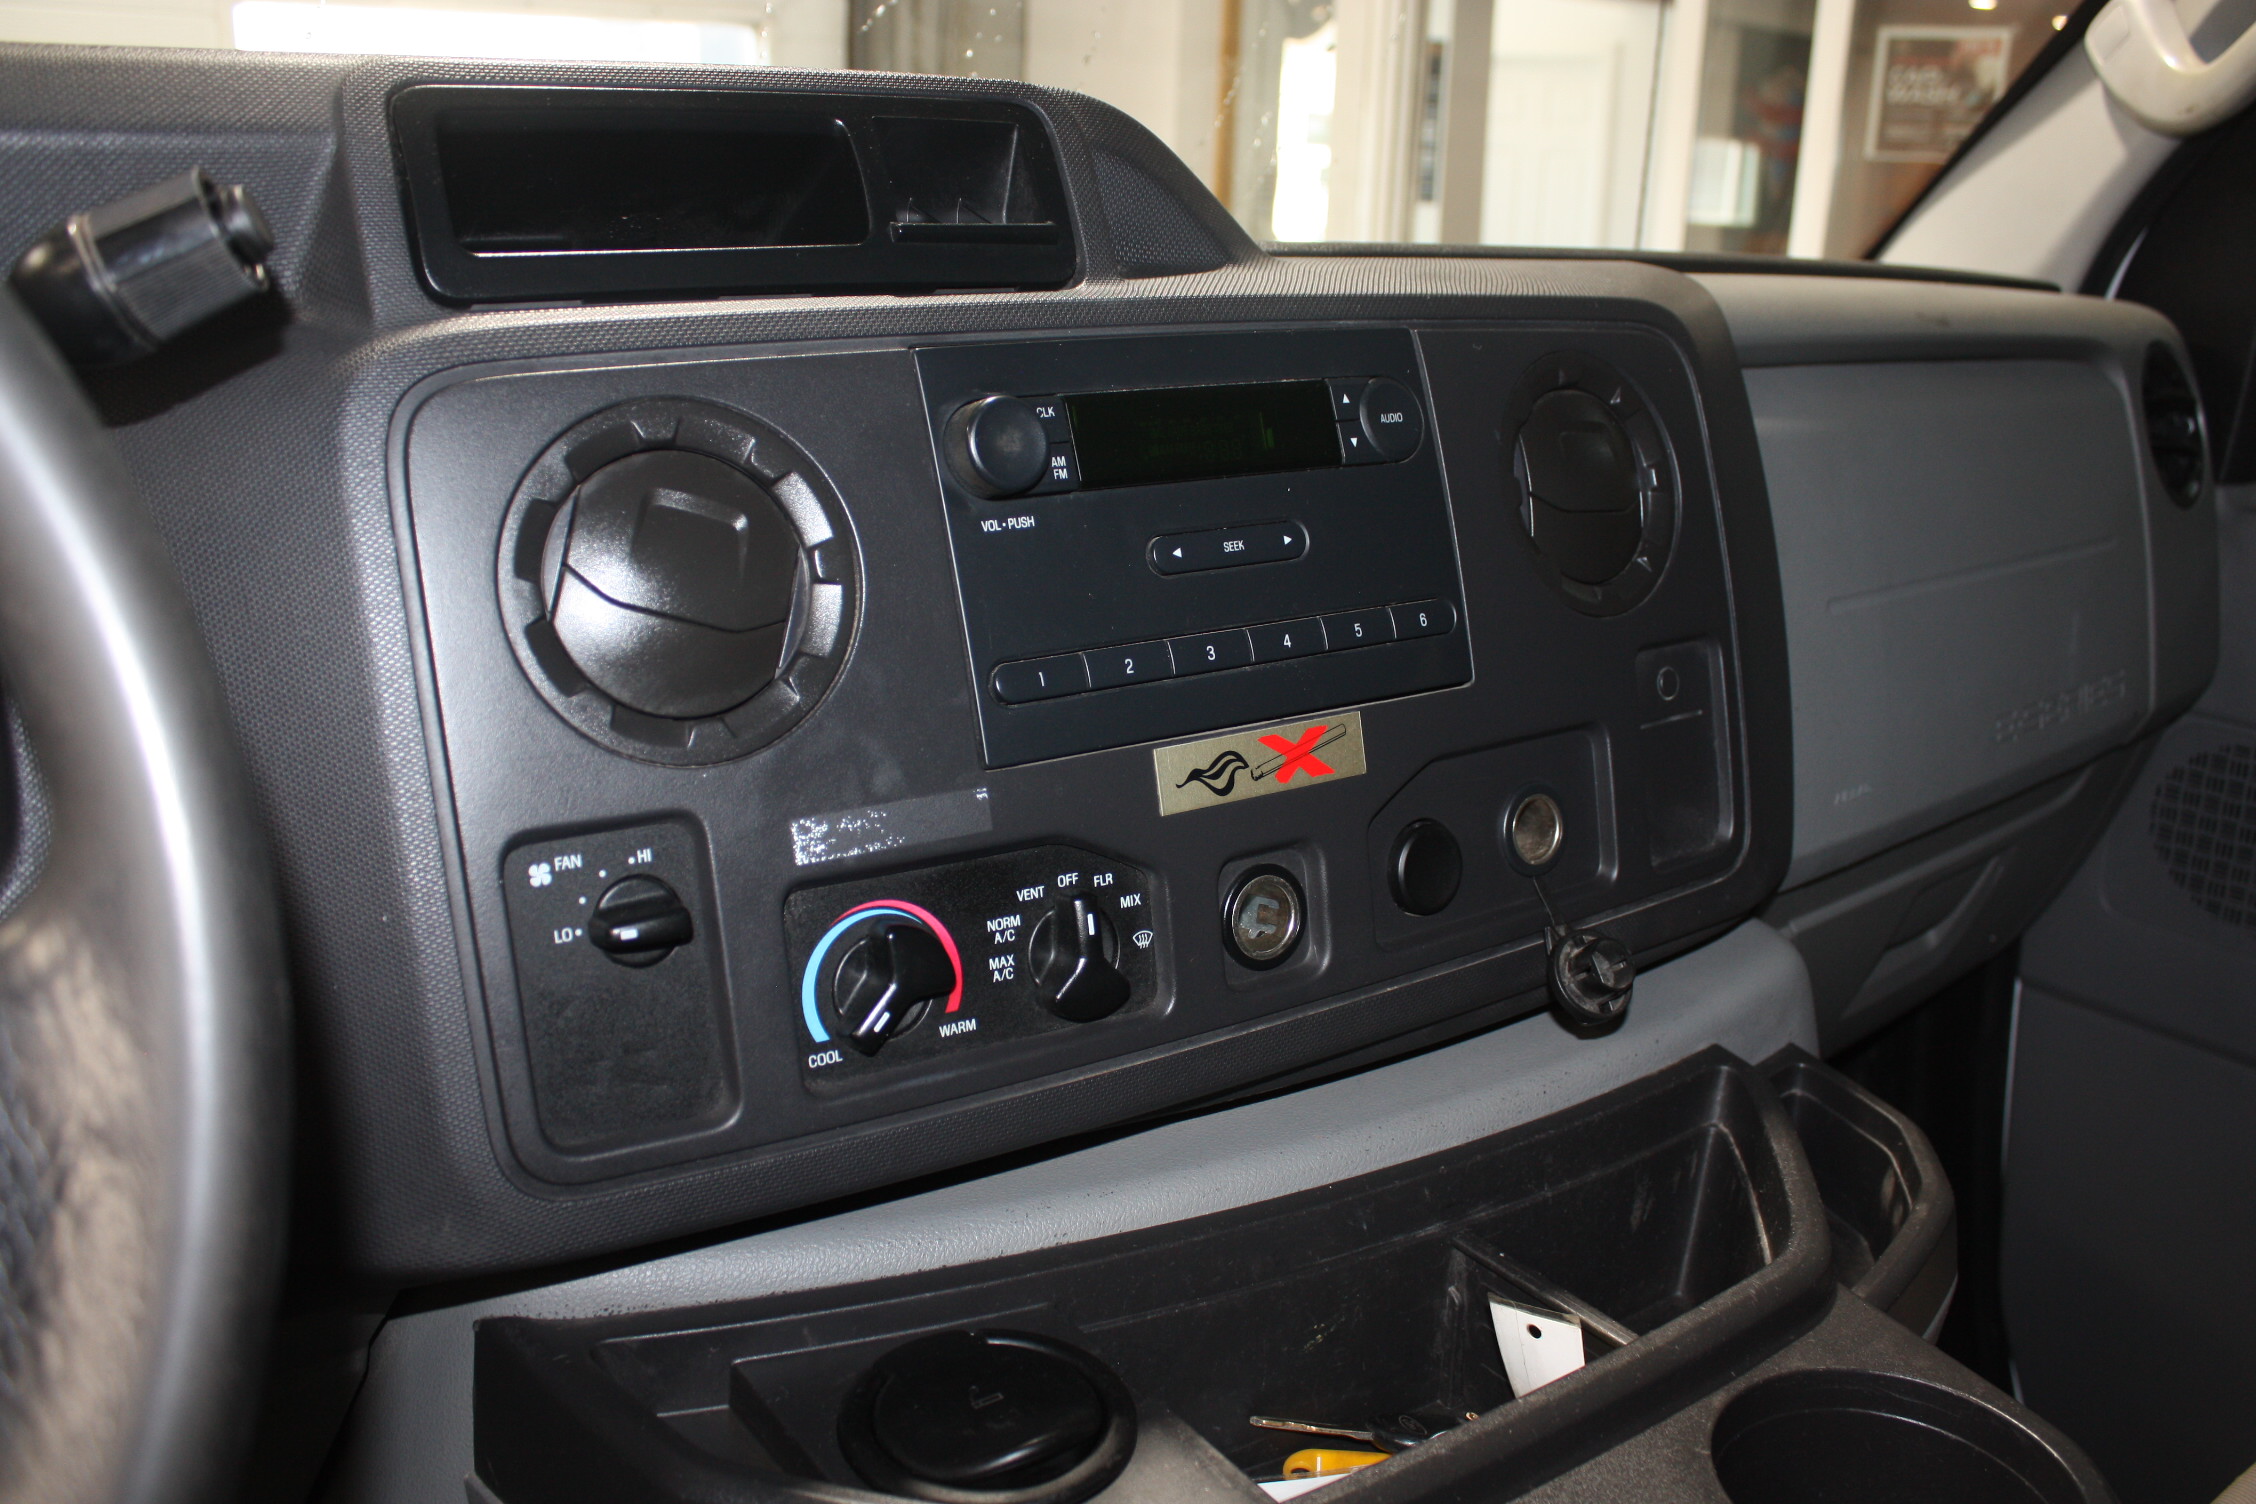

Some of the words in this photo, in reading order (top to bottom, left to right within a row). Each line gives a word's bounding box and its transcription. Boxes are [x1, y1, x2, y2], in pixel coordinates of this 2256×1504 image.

[1037, 407, 1055, 417] CLK
[1381, 413, 1402, 423] AUDIO
[1051, 456, 1067, 467] AM
[1053, 468, 1068, 479] FM
[1224, 541, 1244, 552] SEEK
[1038, 671, 1045, 687] 1
[1125, 659, 1134, 673] 2
[1207, 646, 1215, 660] 3
[1284, 634, 1291, 647] 4
[1355, 624, 1362, 637] 5
[1420, 613, 1427, 626] 6
[554, 854, 582, 871] FAN
[637, 849, 651, 863] HI
[1058, 873, 1078, 887] OFF
[1094, 873, 1112, 887] FLR
[1017, 886, 1044, 901] VENT
[1120, 894, 1142, 908] MIX
[987, 914, 1021, 932] NORM
[554, 928, 573, 943] LO
[994, 930, 1016, 944] A/C
[989, 954, 1015, 970] MAX
[993, 968, 1014, 983] A/C
[939, 1019, 977, 1037] WARM
[809, 1050, 842, 1068] COOL
